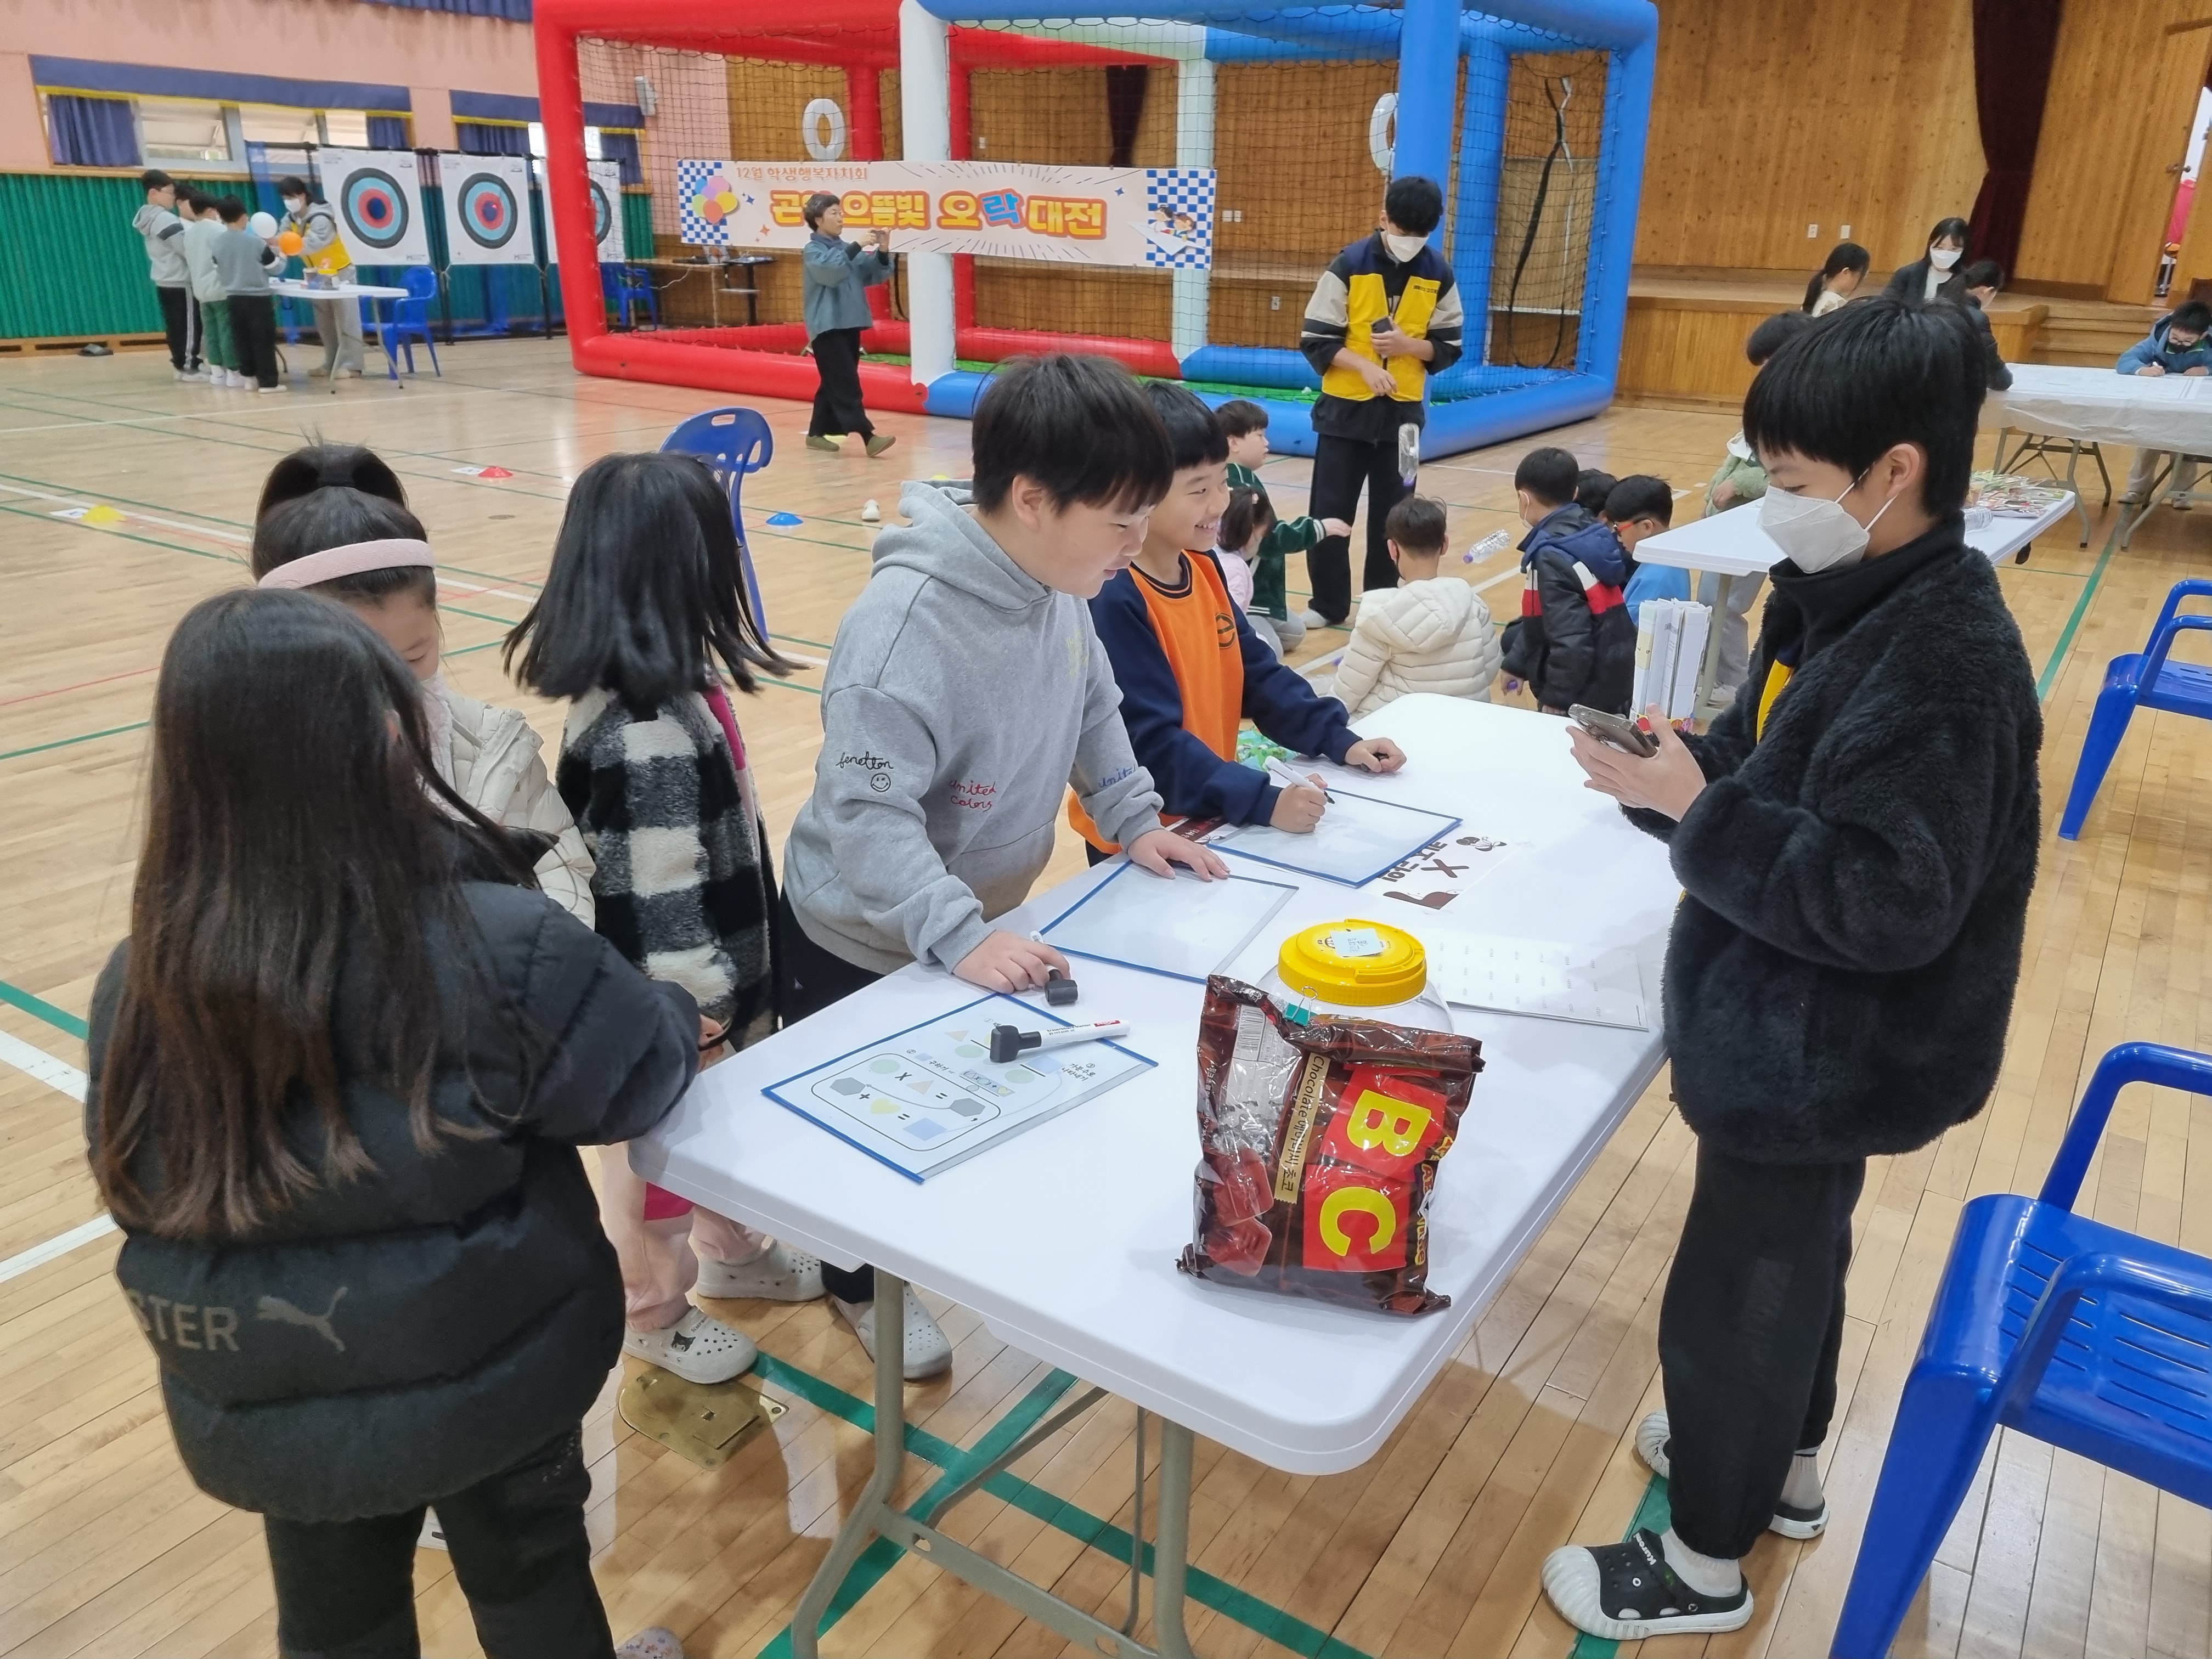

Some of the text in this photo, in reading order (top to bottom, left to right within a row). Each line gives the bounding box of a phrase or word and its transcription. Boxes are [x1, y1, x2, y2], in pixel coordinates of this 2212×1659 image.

[736, 167, 867, 182] 12월 학생행복자치회
[938, 191, 1023, 229] 오락
[1027, 197, 1104, 238] 대전
[1298, 1056, 1324, 1118] Chocolate
[1347, 1089, 1432, 1158] B
[1320, 1187, 1396, 1257] C
